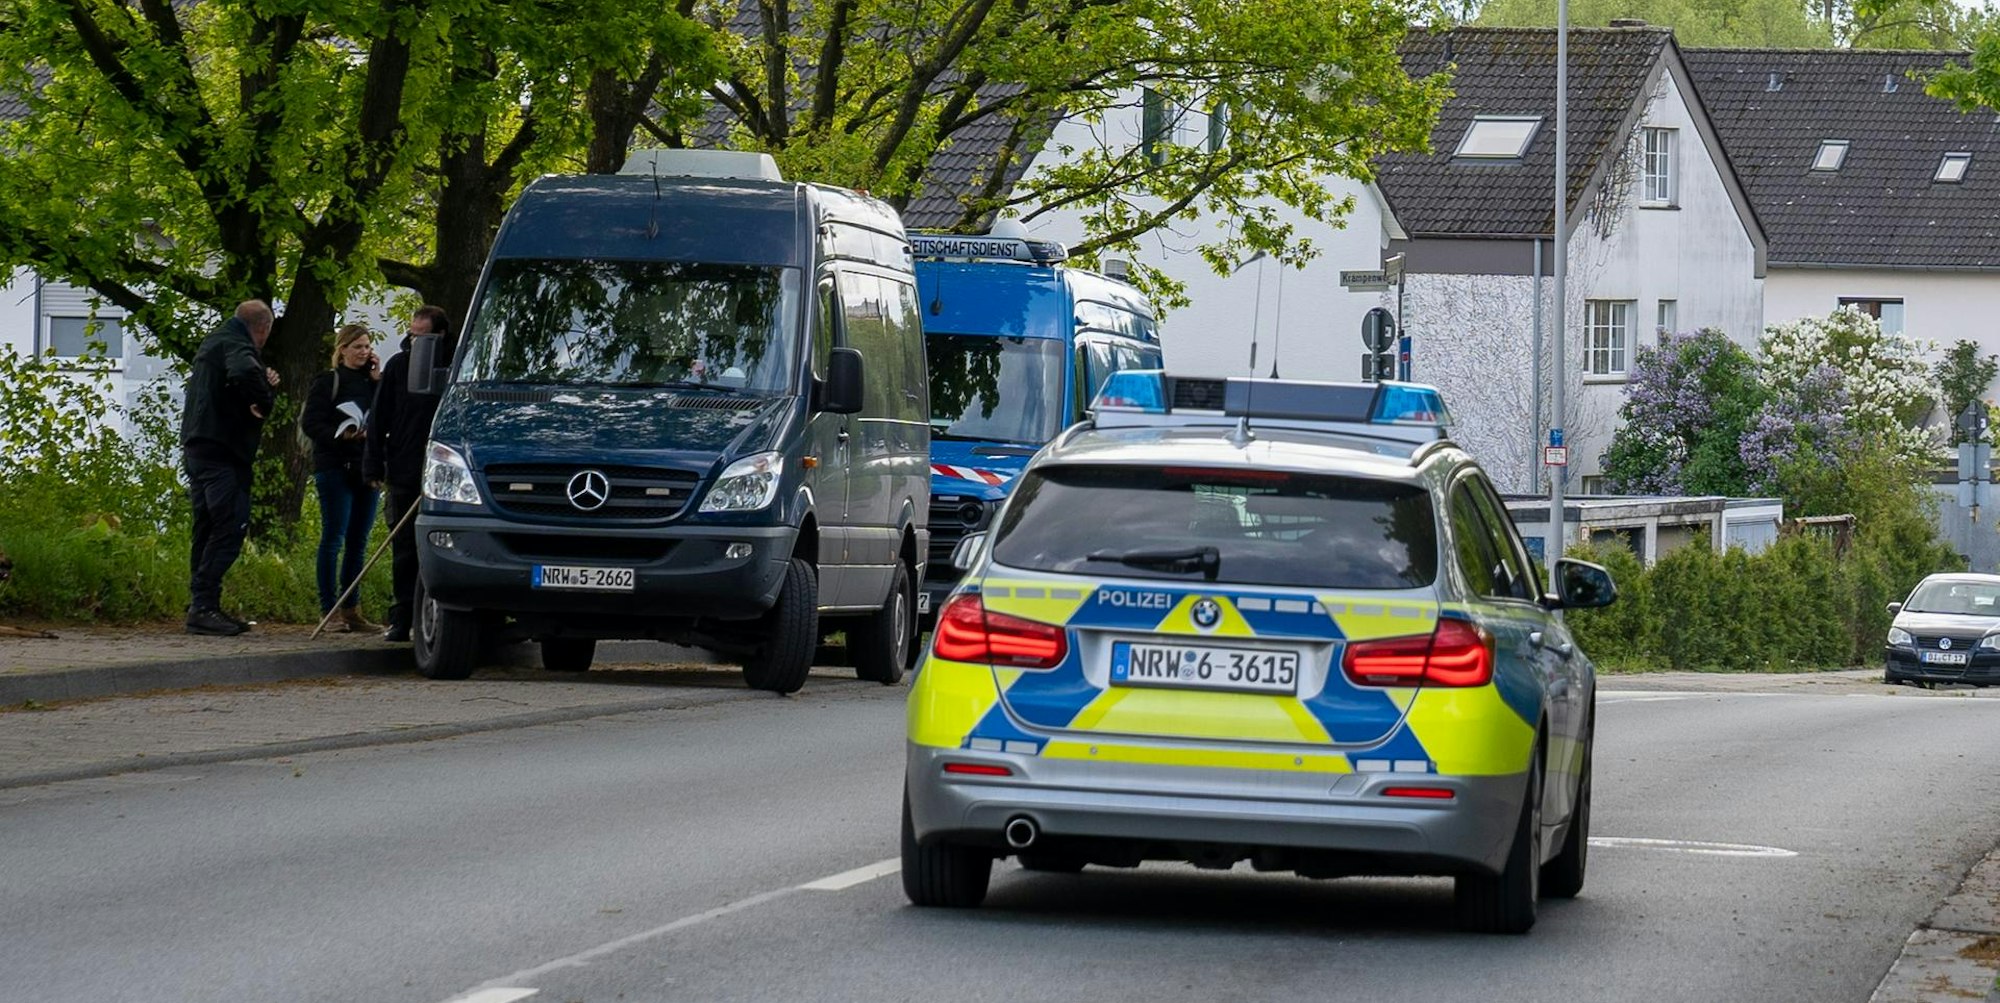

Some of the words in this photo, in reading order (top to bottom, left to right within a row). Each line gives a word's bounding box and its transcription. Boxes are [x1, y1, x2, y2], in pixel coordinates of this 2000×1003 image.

[1342, 273, 1388, 284] Krampenwe
[542, 568, 570, 584] NRW
[579, 569, 632, 587] 5-2662
[1098, 590, 1171, 609] POLIZEI
[1129, 648, 1181, 678] NRW
[1197, 652, 1294, 684] 6-3615
